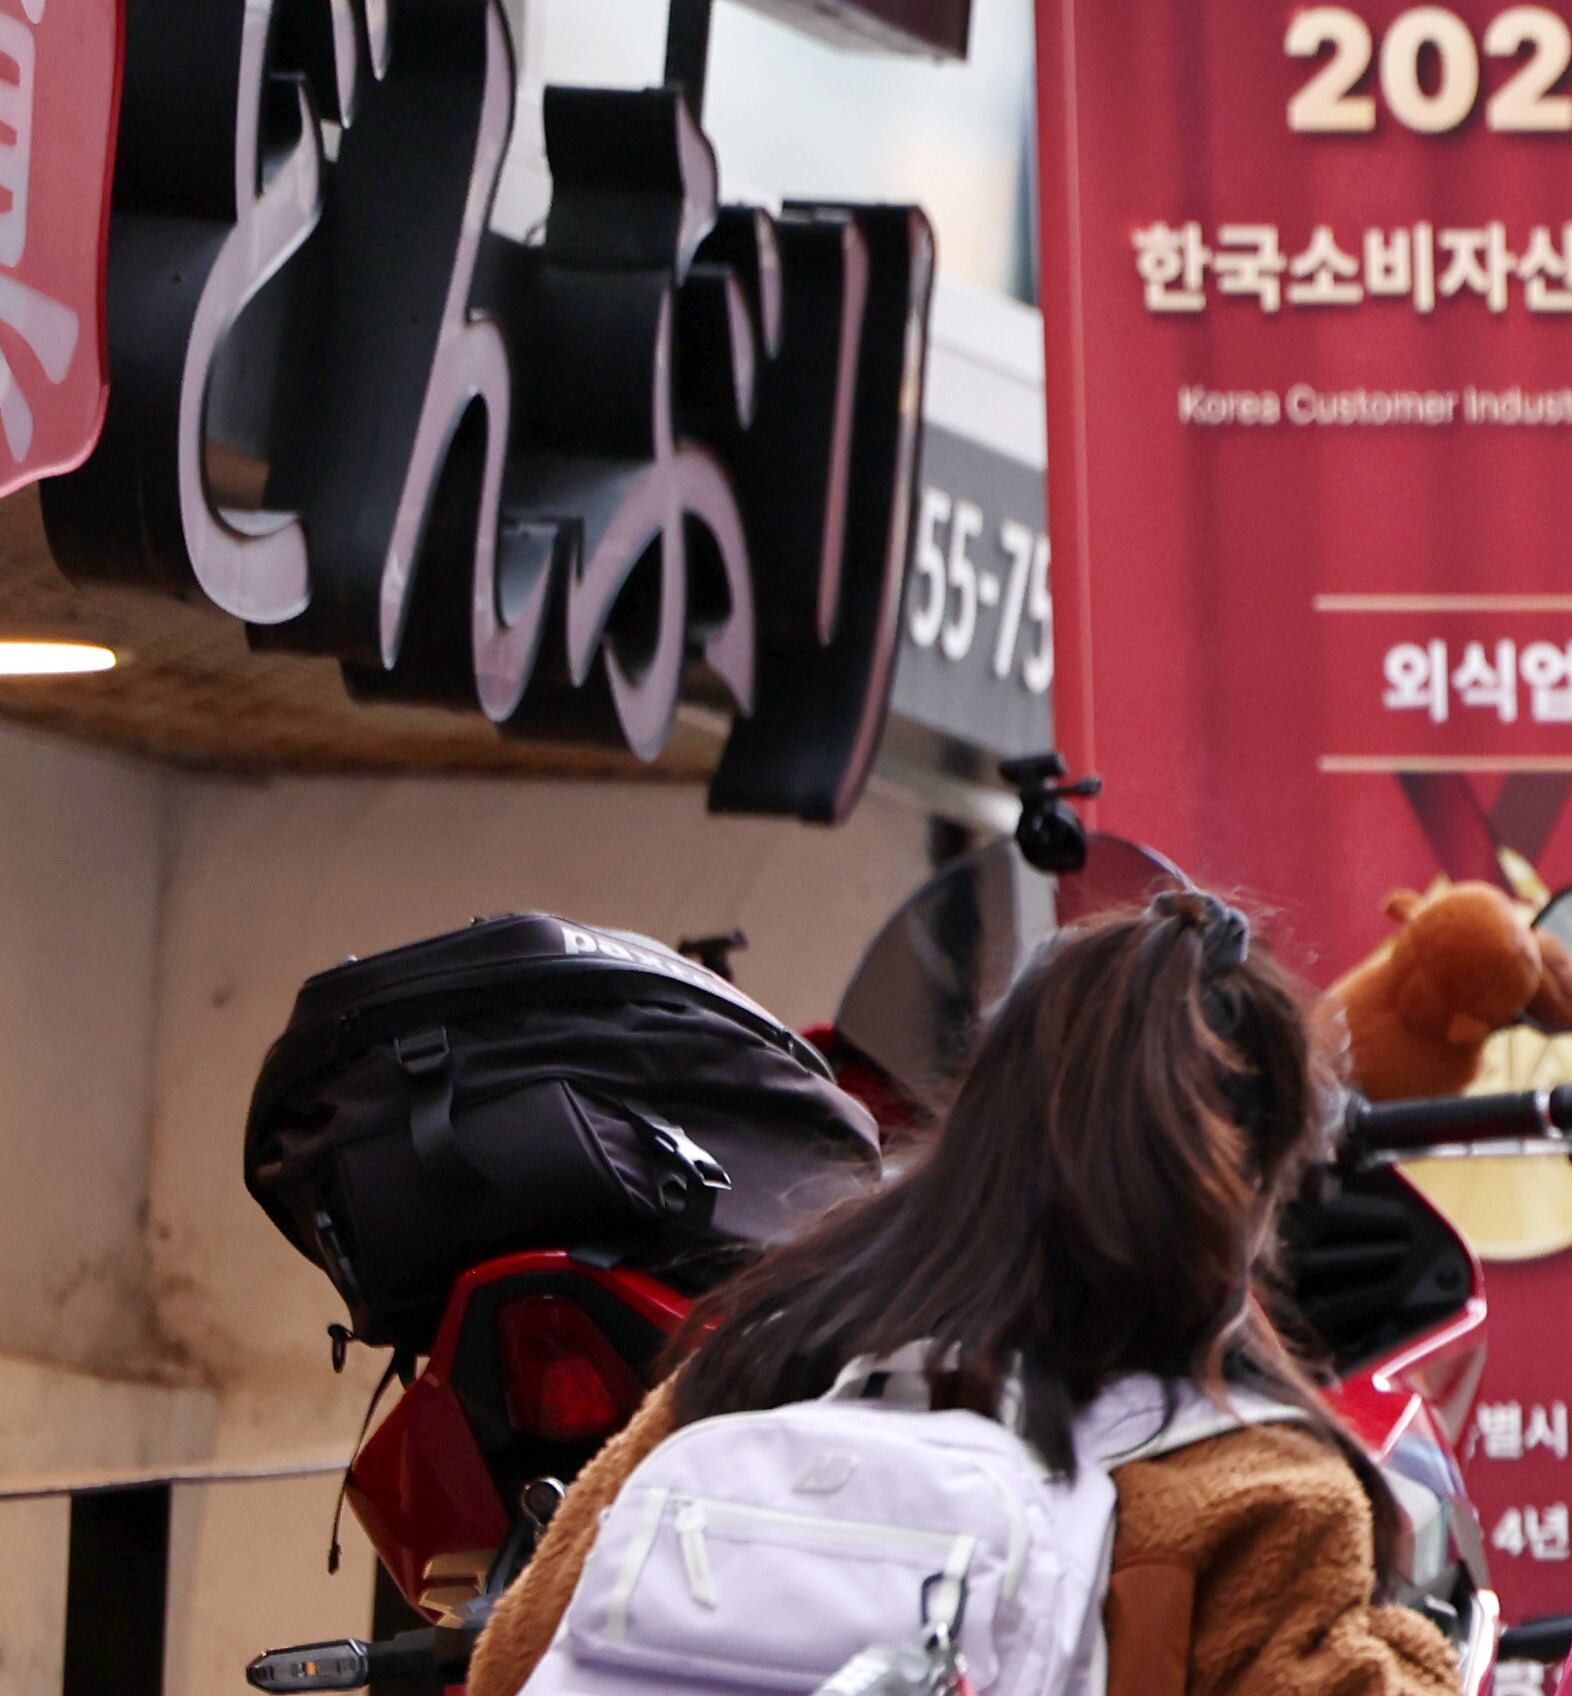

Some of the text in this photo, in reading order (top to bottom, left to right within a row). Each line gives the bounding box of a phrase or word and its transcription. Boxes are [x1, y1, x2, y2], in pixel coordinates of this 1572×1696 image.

[1178, 383, 1281, 425] Korea
[1285, 382, 1457, 426] Customer
[1467, 1400, 1569, 1460] 별시
